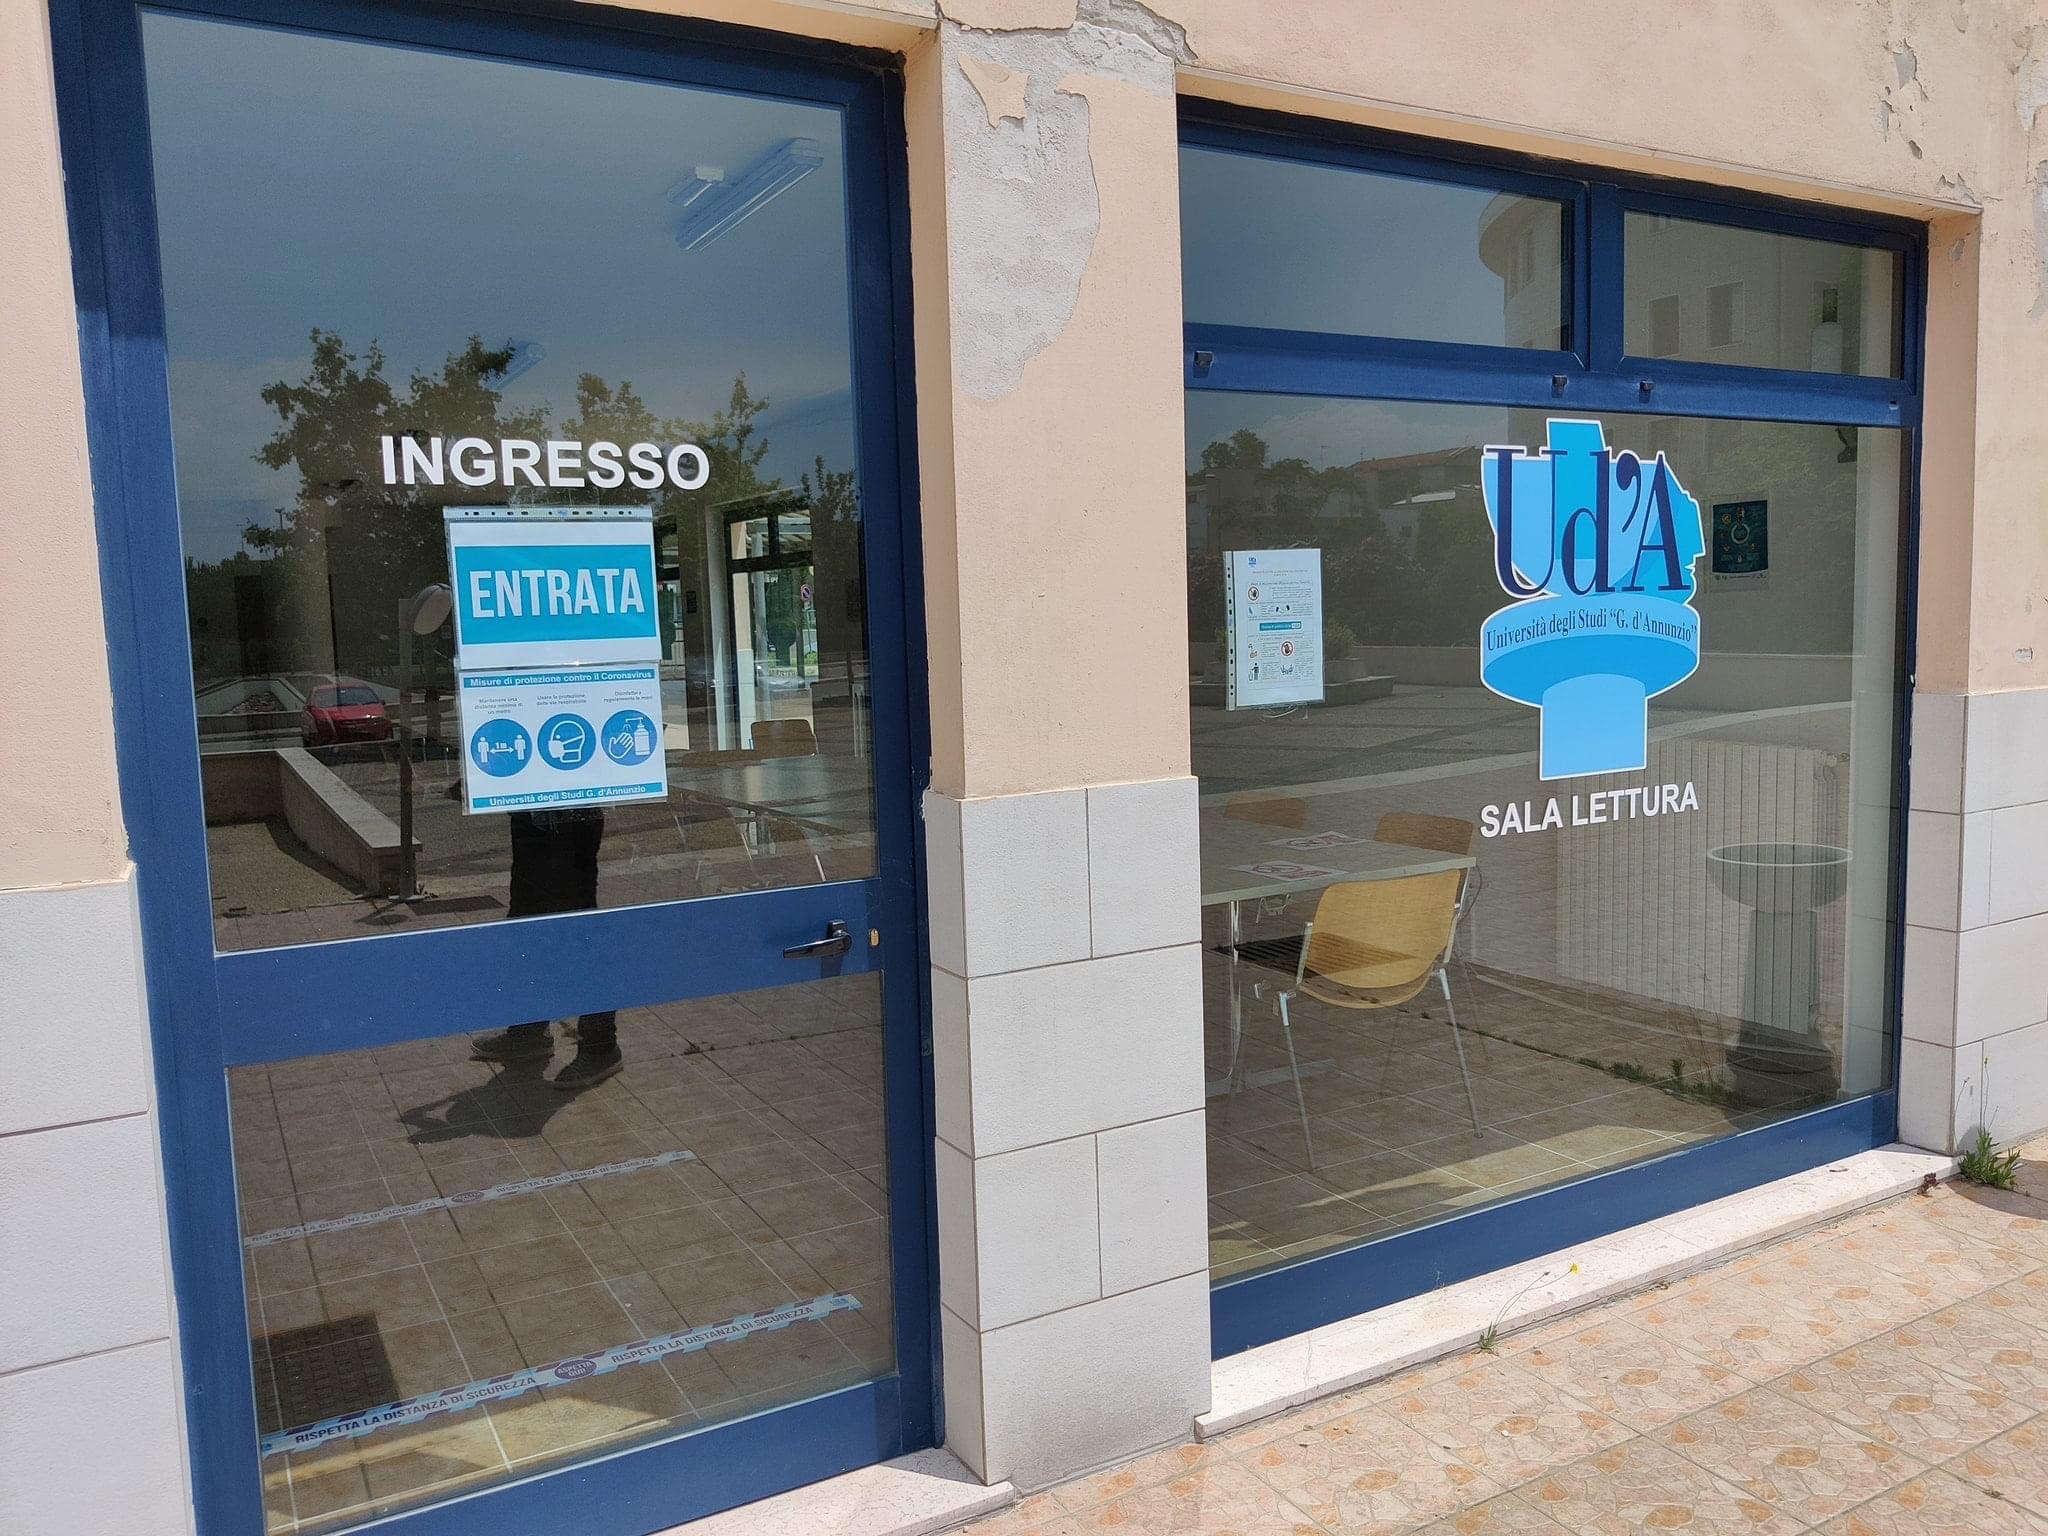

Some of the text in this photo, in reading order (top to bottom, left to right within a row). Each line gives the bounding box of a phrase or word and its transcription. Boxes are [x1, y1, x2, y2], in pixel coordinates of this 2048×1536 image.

[381, 435, 710, 490] INGRESSO
[469, 568, 645, 618] ENTRATA
[1487, 616, 1547, 651] Università
[1549, 611, 1576, 637] degli
[1578, 608, 1607, 629] Studi
[470, 671, 652, 687] Misure di protezione contro il Coronavirus
[489, 785, 646, 807] Università degli Studi G. d'Annunzio
[1480, 781, 1699, 838] SALA LETTURA
[611, 1306, 814, 1364] RISPETTA LA DISTANZA DI SICUREZZA
[295, 1376, 537, 1445] RISPETTA LA DISTANZA DI SICUREZZA
